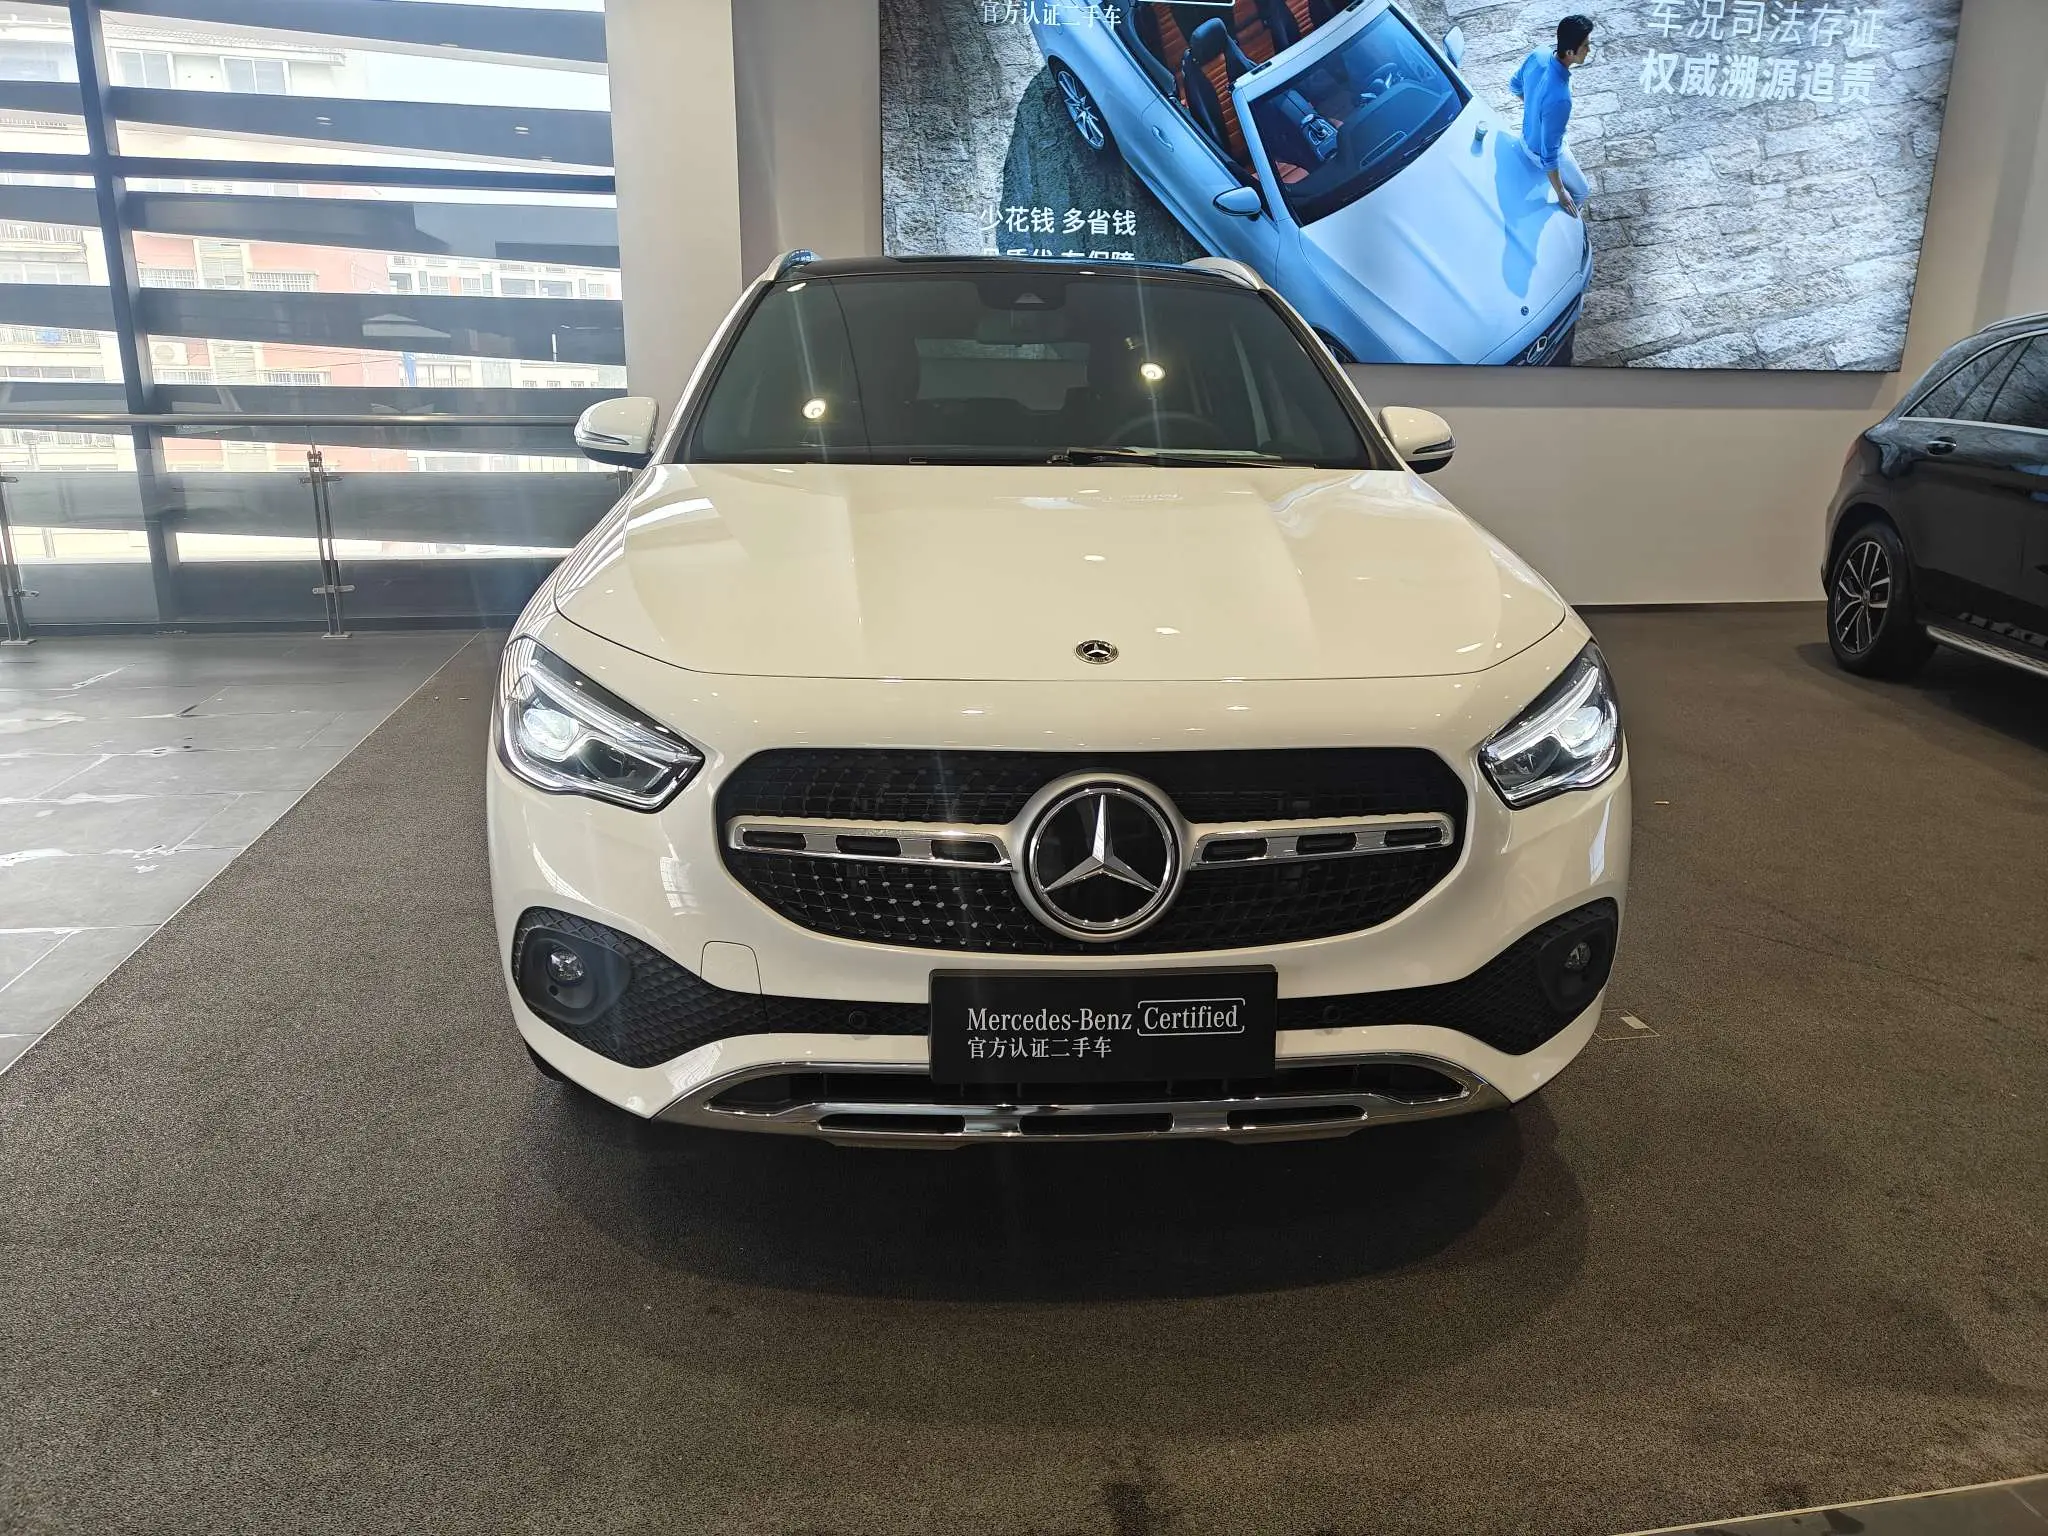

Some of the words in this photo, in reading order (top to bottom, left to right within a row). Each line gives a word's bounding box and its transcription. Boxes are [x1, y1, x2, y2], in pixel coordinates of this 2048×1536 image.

[980, 1, 1122, 29] 官方认证二手车
[1647, 0, 1887, 48] 车况司法存证
[1639, 49, 1875, 103] 权威溯源追责
[980, 205, 1055, 234] 少花钱
[1062, 207, 1137, 236] 多省钱
[966, 1007, 1132, 1031] Mercedes-Benz
[1144, 1005, 1238, 1030] Certified
[967, 1037, 1112, 1058] 官方认证二手车
